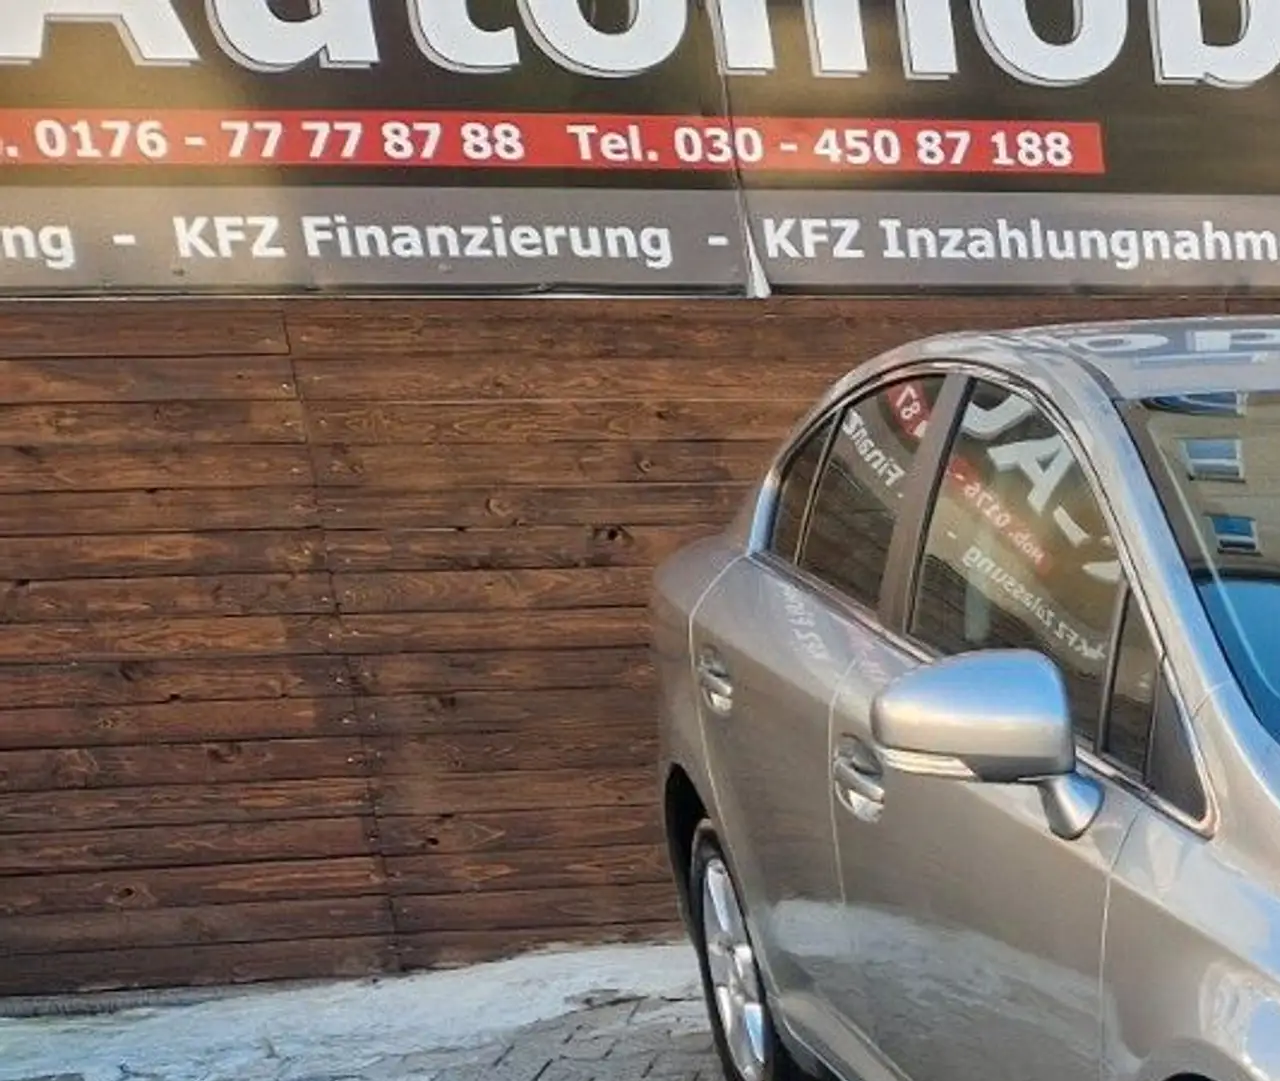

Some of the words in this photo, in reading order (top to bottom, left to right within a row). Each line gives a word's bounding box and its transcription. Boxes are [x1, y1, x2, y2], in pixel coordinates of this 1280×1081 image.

[35, 120, 168, 159] 0176
[221, 121, 283, 158] 77
[301, 122, 363, 159] 77
[381, 122, 442, 160] 87
[461, 123, 525, 161] 88
[568, 124, 658, 162] Tel.
[673, 127, 763, 165] 030
[814, 130, 898, 165] 450
[916, 131, 971, 165] 87
[991, 131, 1073, 167] 188
[172, 217, 285, 258] KFZ
[301, 217, 673, 268] Finanzierung
[763, 219, 864, 259] KFZ
